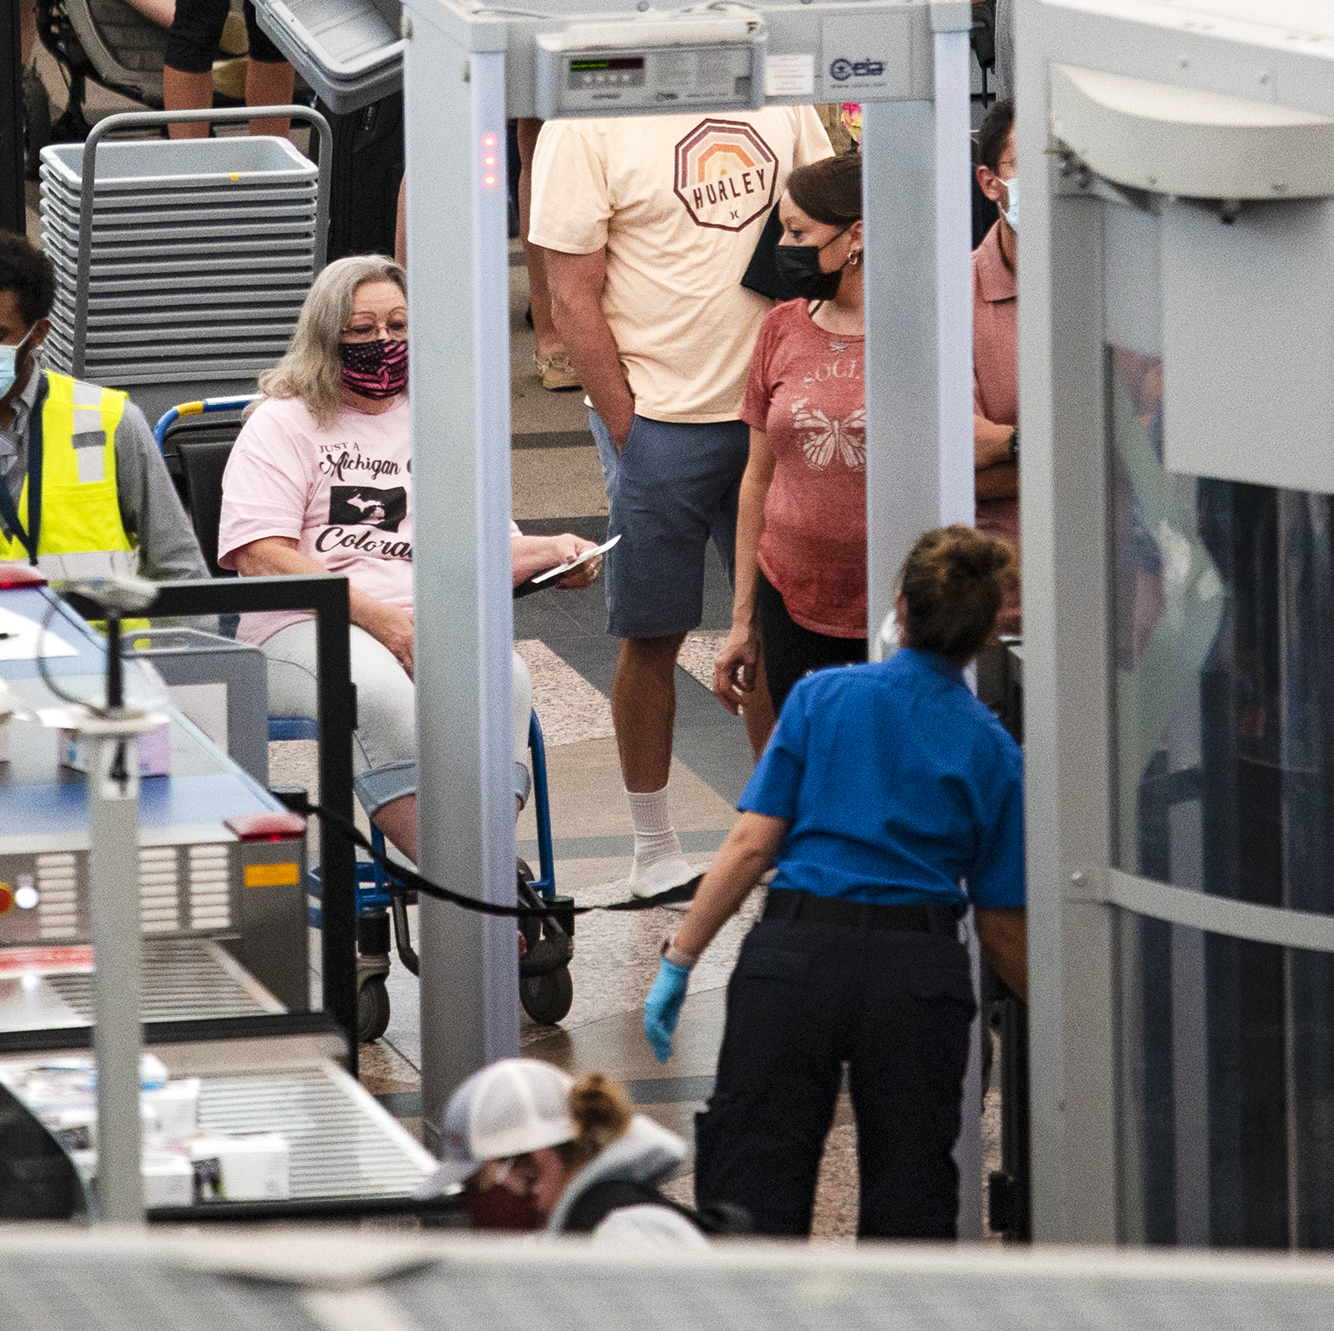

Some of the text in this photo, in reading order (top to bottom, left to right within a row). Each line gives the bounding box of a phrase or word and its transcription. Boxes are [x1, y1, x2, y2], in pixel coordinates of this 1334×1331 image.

[692, 167, 766, 210] HURLEY
[319, 442, 361, 453] JUST A
[319, 451, 401, 482] Michigan
